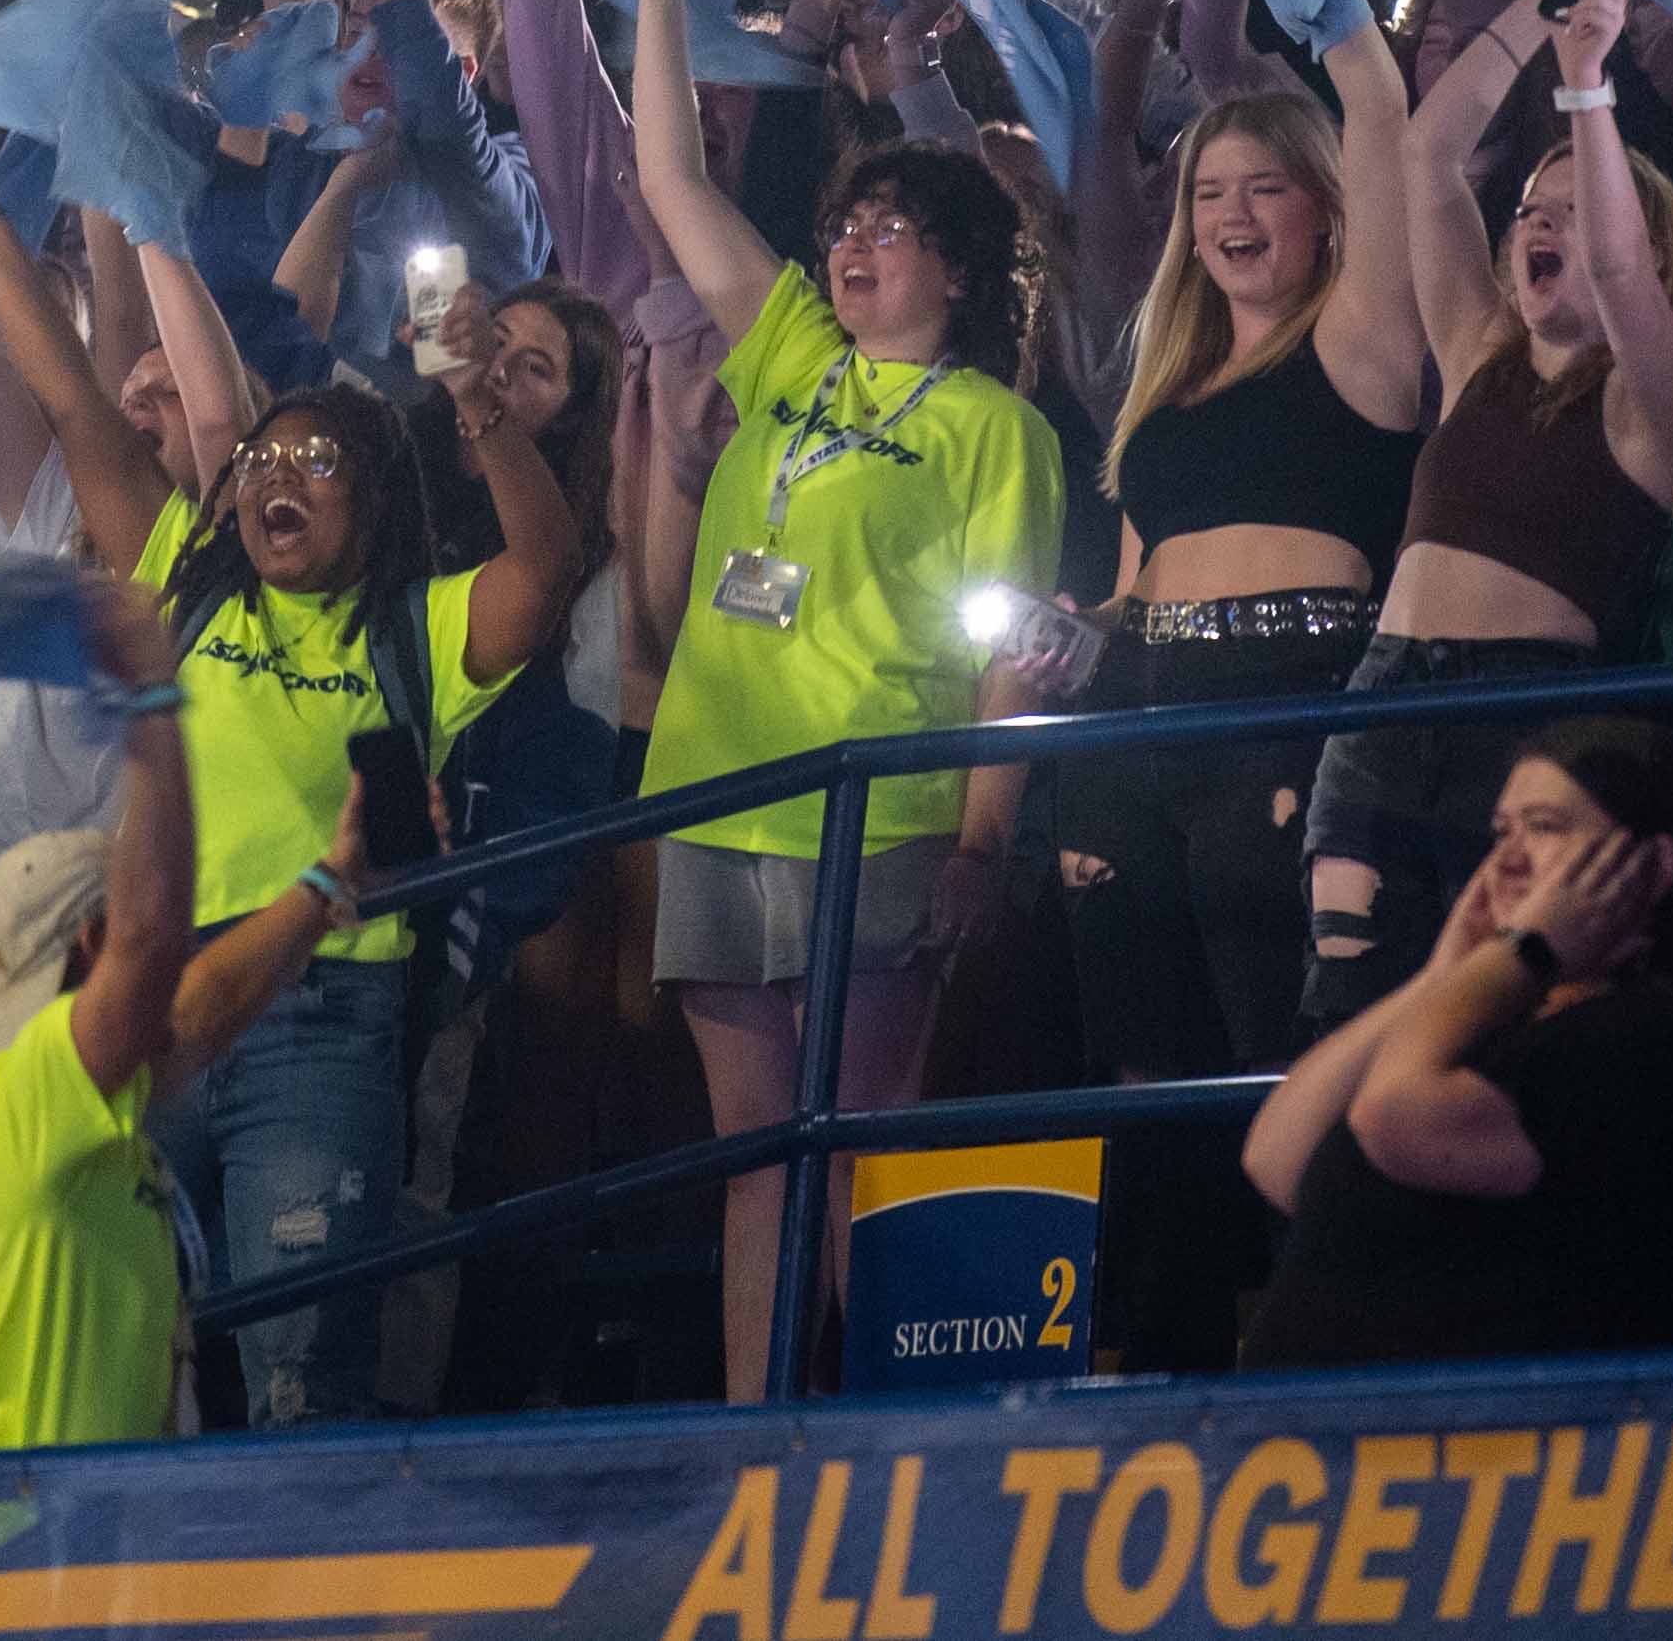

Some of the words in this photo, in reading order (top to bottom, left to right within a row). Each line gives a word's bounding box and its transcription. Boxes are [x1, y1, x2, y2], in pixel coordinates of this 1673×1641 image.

[894, 1314, 1027, 1358] SECTION
[1037, 1257, 1076, 1351] 2
[663, 1456, 937, 1641] ALL
